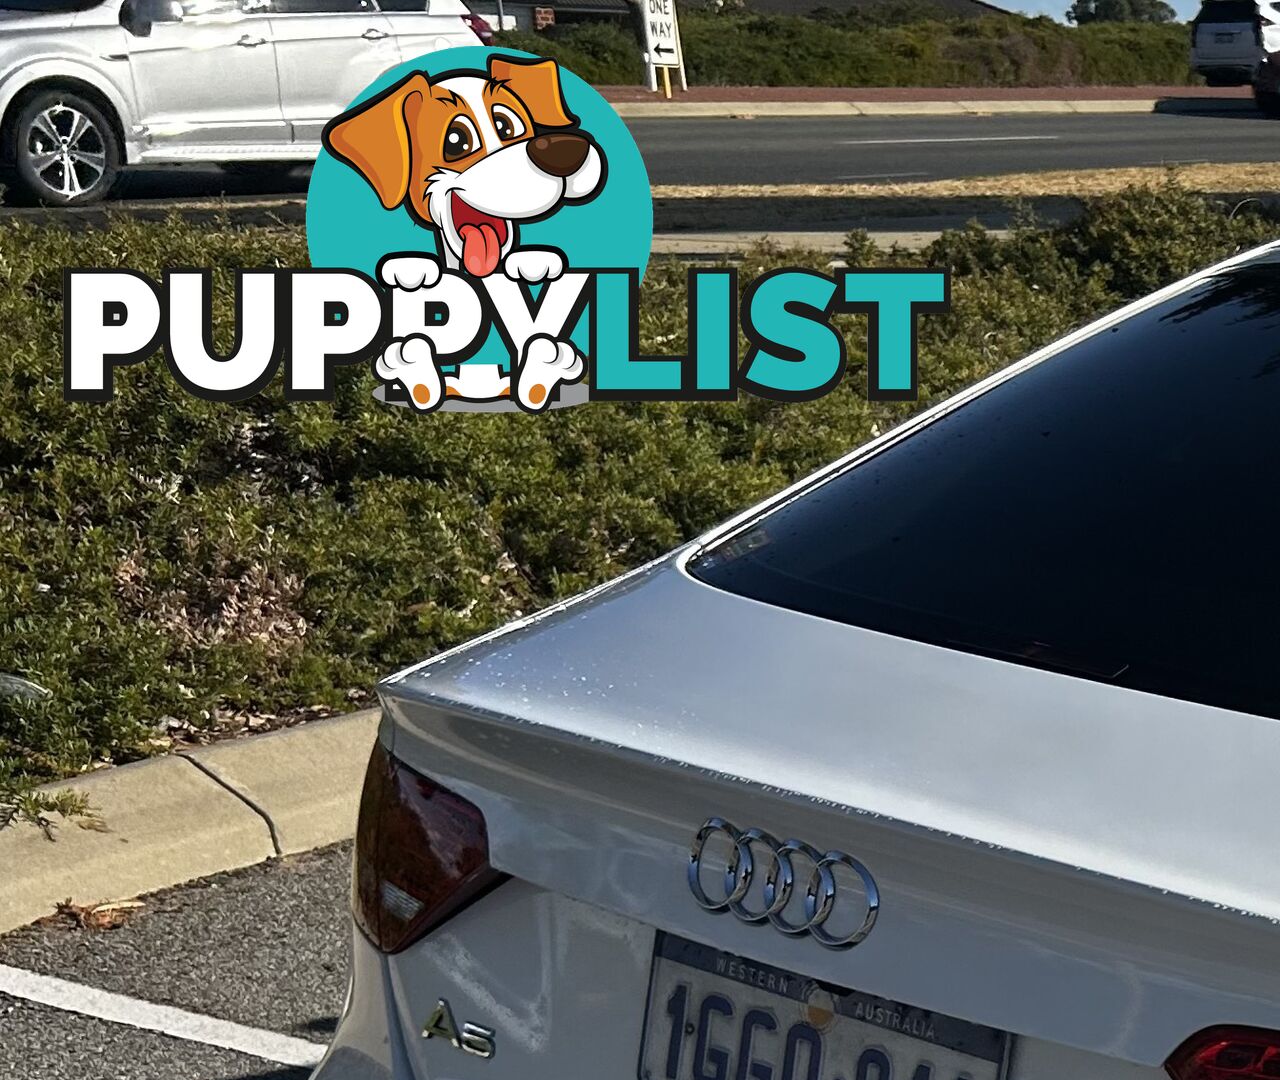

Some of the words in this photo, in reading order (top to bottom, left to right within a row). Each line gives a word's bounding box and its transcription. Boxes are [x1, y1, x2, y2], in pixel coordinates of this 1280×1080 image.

[649, 0, 670, 15] ONE
[650, 21, 671, 38] WAY
[715, 957, 790, 993] WESTERN
[855, 1002, 937, 1040] AUSTRALIA
[421, 997, 496, 1060] A5
